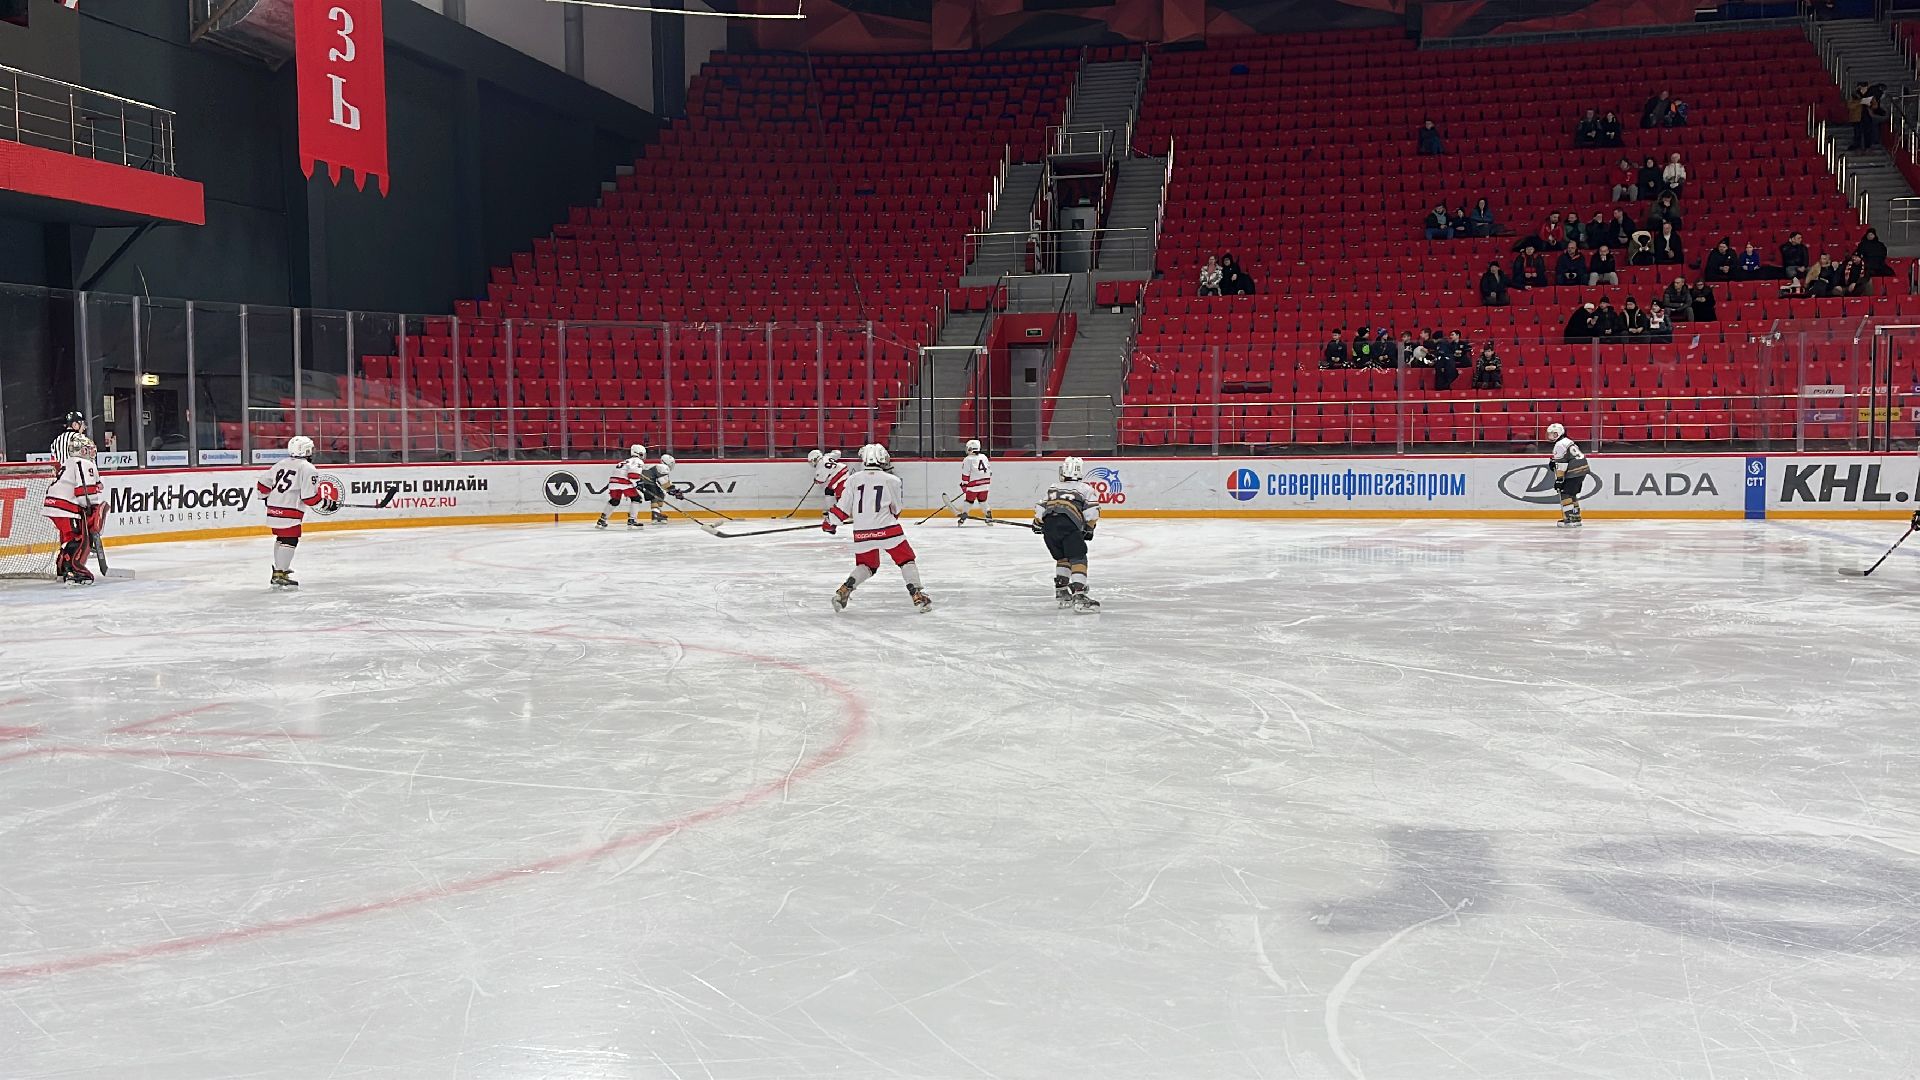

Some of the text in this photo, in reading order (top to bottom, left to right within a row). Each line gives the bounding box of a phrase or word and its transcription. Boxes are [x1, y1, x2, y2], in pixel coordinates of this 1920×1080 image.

[977, 459, 987, 473] 4
[422, 475, 488, 491] ОНЛАЙН
[1267, 468, 1466, 501] севернефтегазпром
[1613, 472, 1719, 496] LADA
[1780, 464, 1920, 502] KHL.
[110, 482, 254, 514] MarkHockey
[857, 483, 884, 514] 11
[119, 510, 228, 526] MAKE YOURSELF
